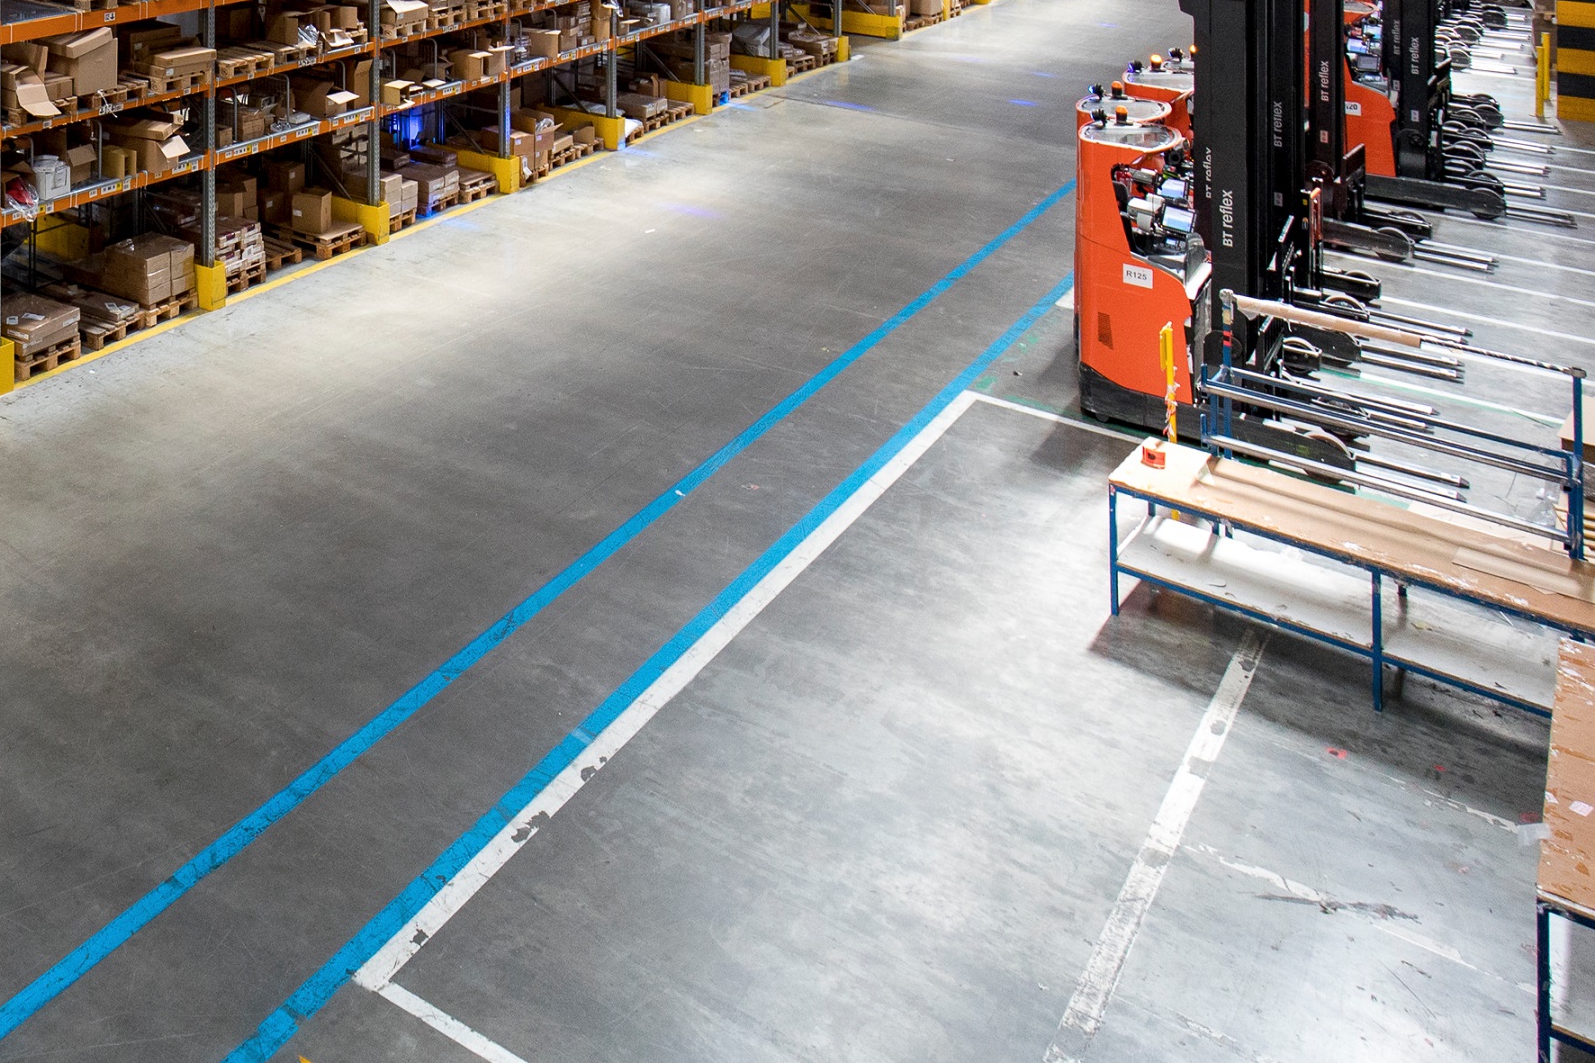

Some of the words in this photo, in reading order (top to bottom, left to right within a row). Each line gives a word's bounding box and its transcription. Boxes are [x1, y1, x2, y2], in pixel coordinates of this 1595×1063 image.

[1408, 37, 1420, 62] reflex
[1318, 60, 1329, 90] reflex
[1411, 62, 1420, 75] BT
[1321, 91, 1329, 102] BT
[1273, 101, 1283, 131] reflex
[1274, 133, 1283, 148] BT
[1219, 189, 1234, 230] reflex
[1222, 231, 1234, 248] BT
[1125, 269, 1148, 281] R125
